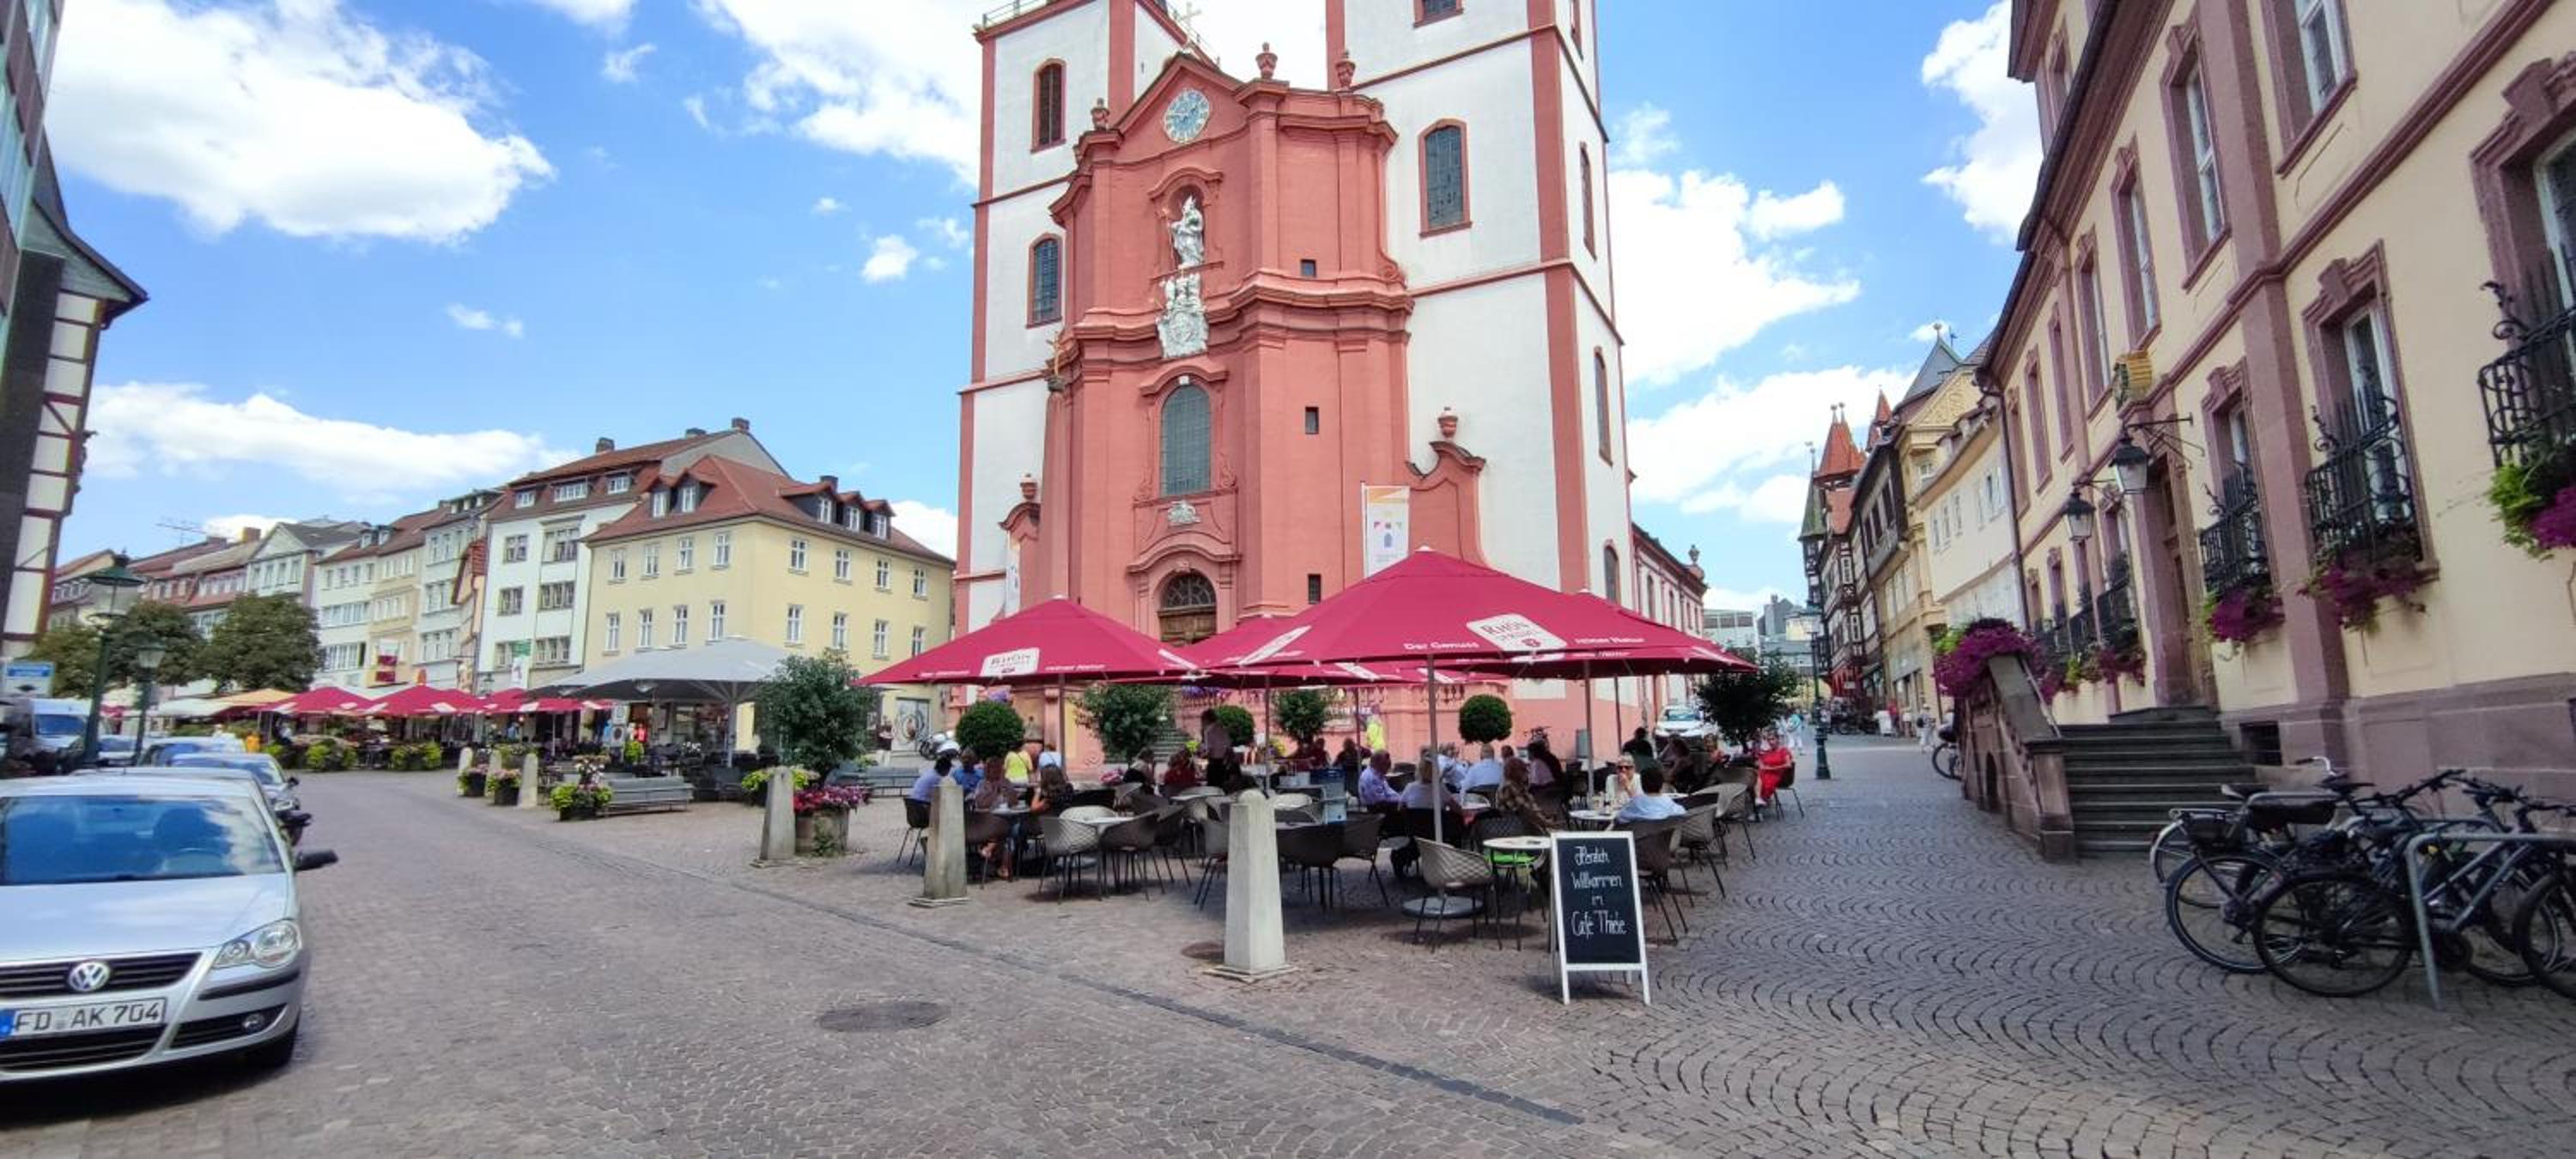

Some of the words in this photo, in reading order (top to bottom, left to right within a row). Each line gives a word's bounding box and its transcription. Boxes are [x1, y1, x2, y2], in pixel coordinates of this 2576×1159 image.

[15, 1011, 52, 1031] FD
[70, 1007, 106, 1029] AK
[114, 1002, 160, 1024] 704
